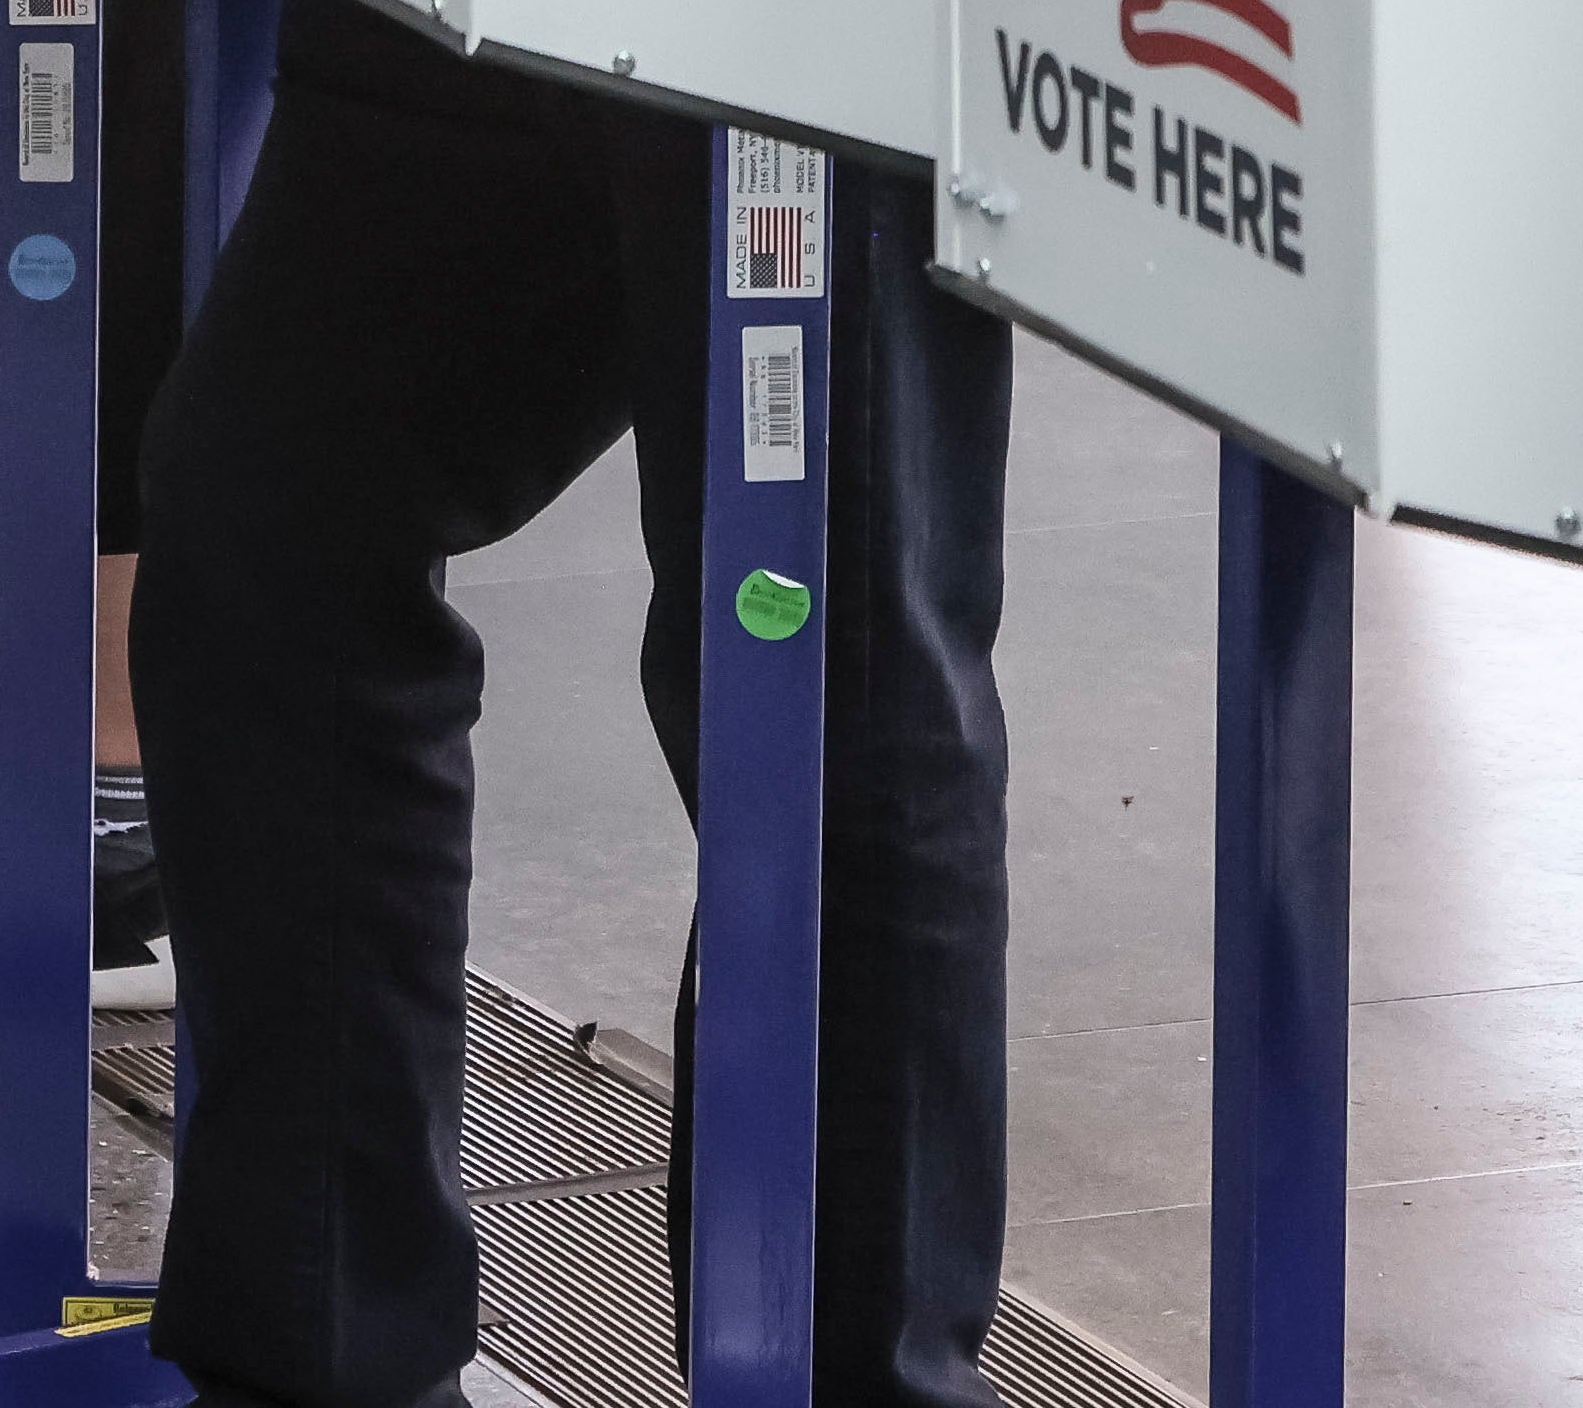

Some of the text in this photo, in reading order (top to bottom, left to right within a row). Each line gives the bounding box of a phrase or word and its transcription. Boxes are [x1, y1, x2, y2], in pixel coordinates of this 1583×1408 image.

[748, 150, 758, 193] Freeport,
[995, 28, 1306, 278] VOTE HERE
[760, 167, 770, 193] (516)
[796, 159, 805, 193] MODEL
[736, 206, 747, 289] MADE IN
